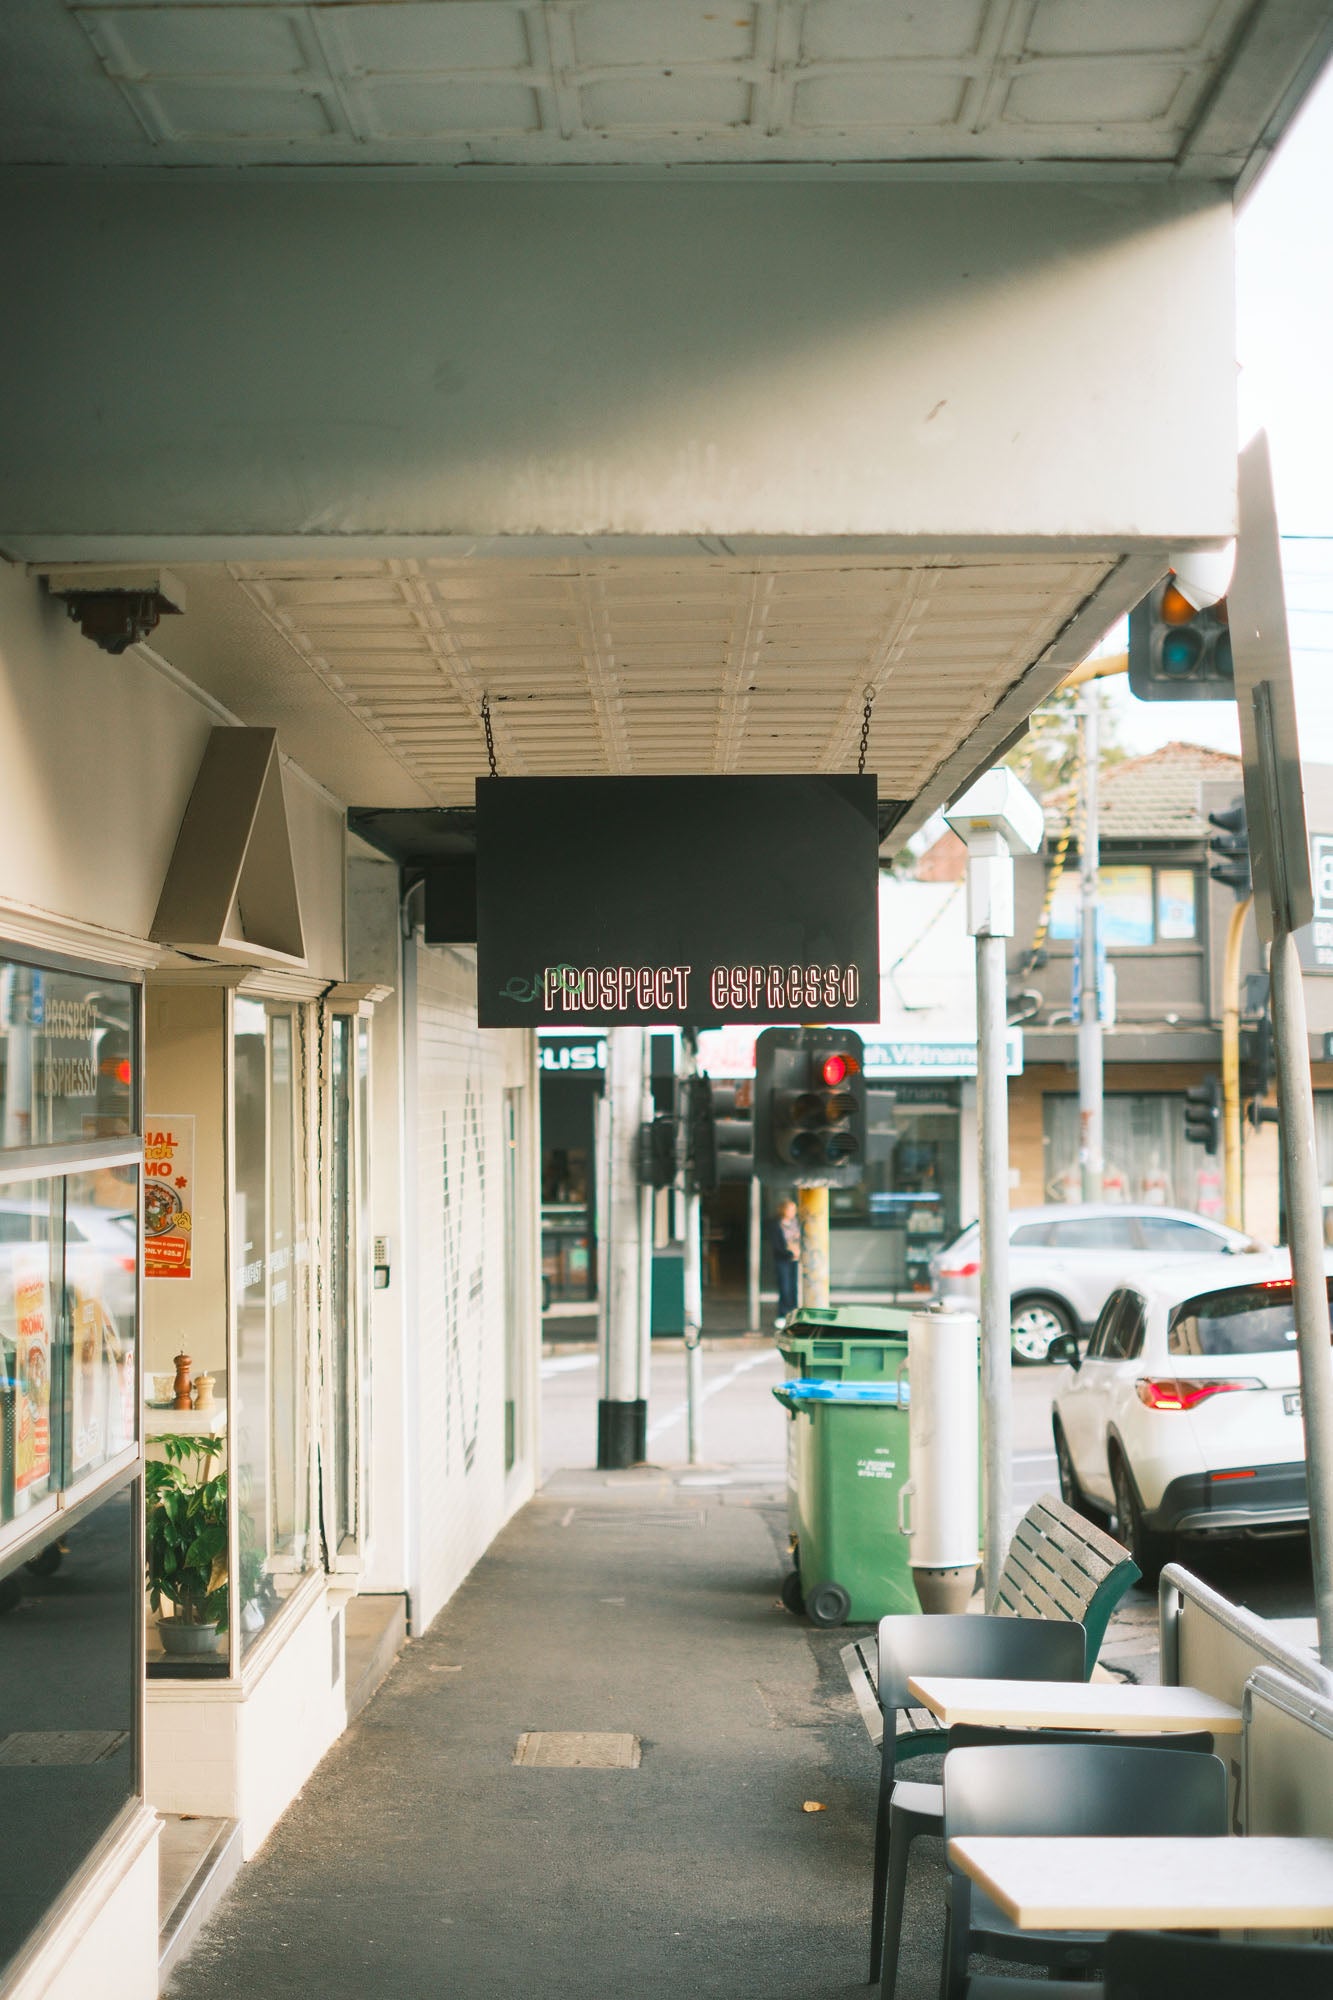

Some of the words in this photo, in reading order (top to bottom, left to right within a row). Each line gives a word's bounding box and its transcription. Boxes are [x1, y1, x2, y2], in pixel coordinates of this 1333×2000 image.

[44, 999, 98, 1040] PROSPECT
[44, 1057, 98, 1096] ESPRESSO
[145, 1132, 178, 1146] IAL
